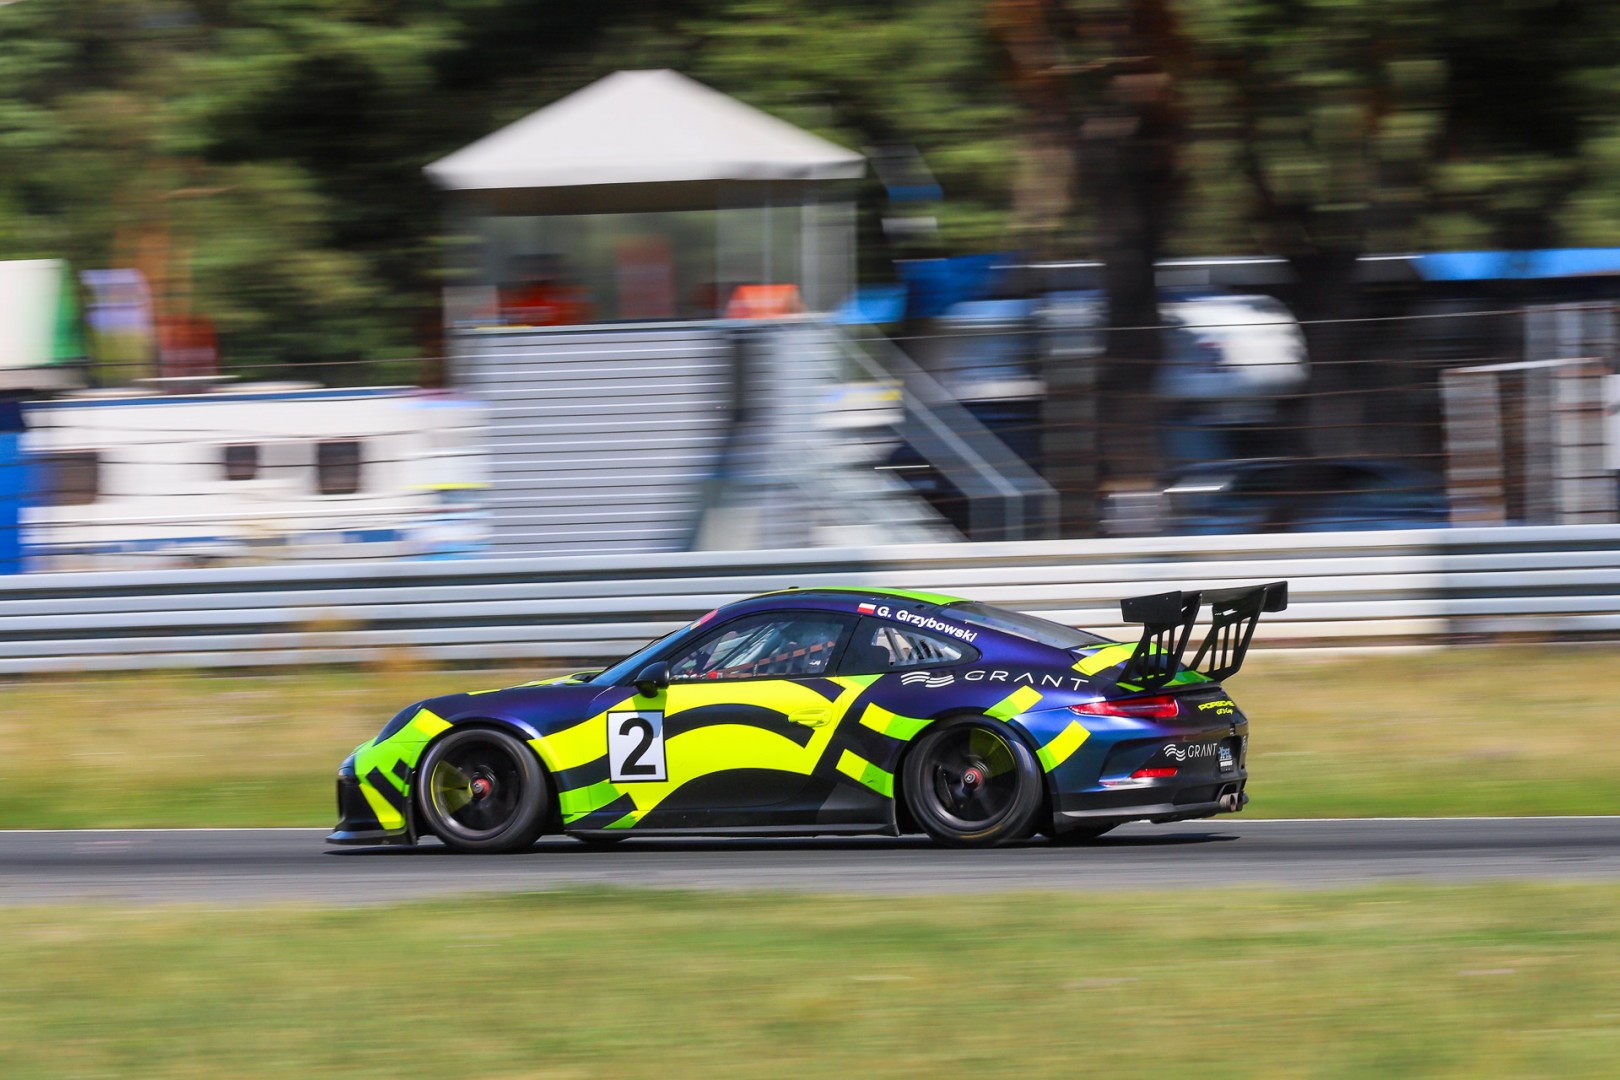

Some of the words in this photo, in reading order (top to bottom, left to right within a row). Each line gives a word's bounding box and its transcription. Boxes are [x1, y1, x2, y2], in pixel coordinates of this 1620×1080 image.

[877, 606, 892, 618] G.
[896, 610, 978, 643] Grzybowski
[964, 670, 1089, 691] GRANT
[619, 717, 657, 776] 2
[1187, 743, 1218, 758] GRANT
